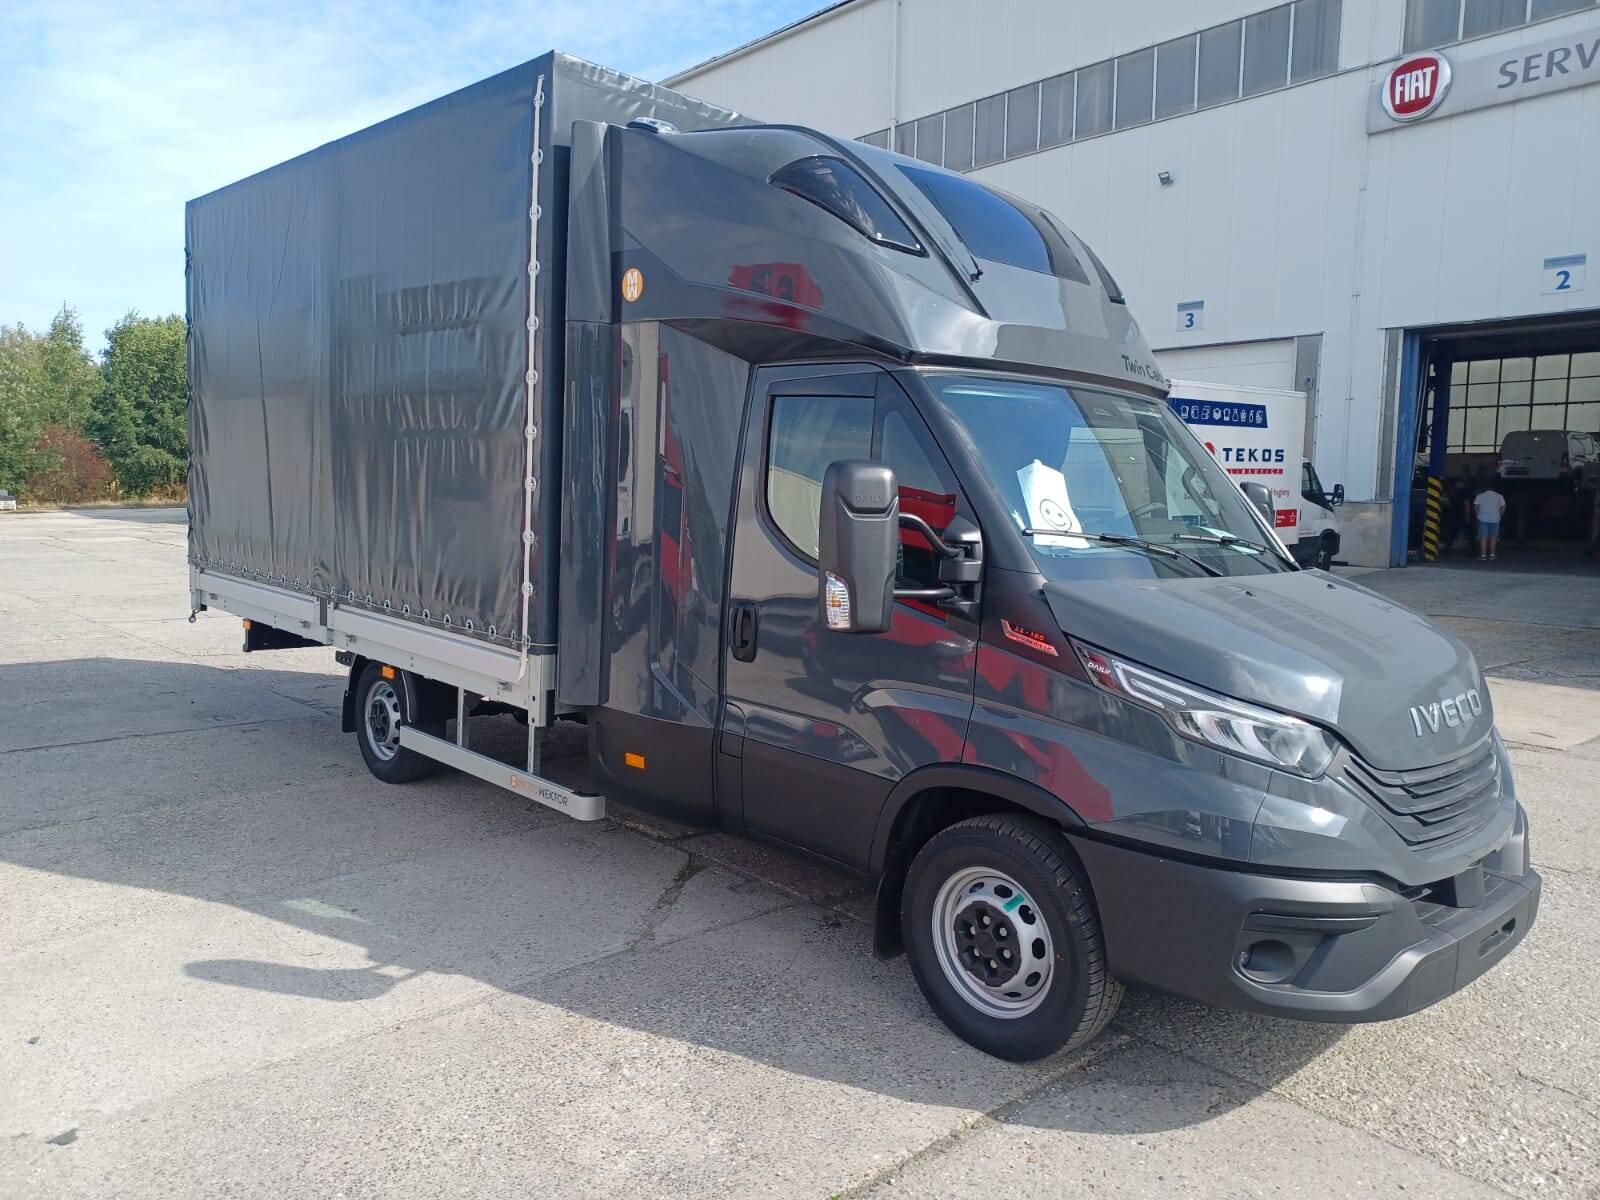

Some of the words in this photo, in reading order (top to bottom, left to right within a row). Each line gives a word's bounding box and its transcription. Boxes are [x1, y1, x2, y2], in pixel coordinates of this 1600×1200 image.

[1394, 66, 1436, 105] FIAT
[1555, 270, 1571, 290] 2
[1185, 312, 1195, 328] 3
[1121, 354, 1146, 376] Twin
[1222, 447, 1285, 463] TEKOS
[1087, 661, 1111, 675] DAILY
[1408, 688, 1482, 738] IVECO
